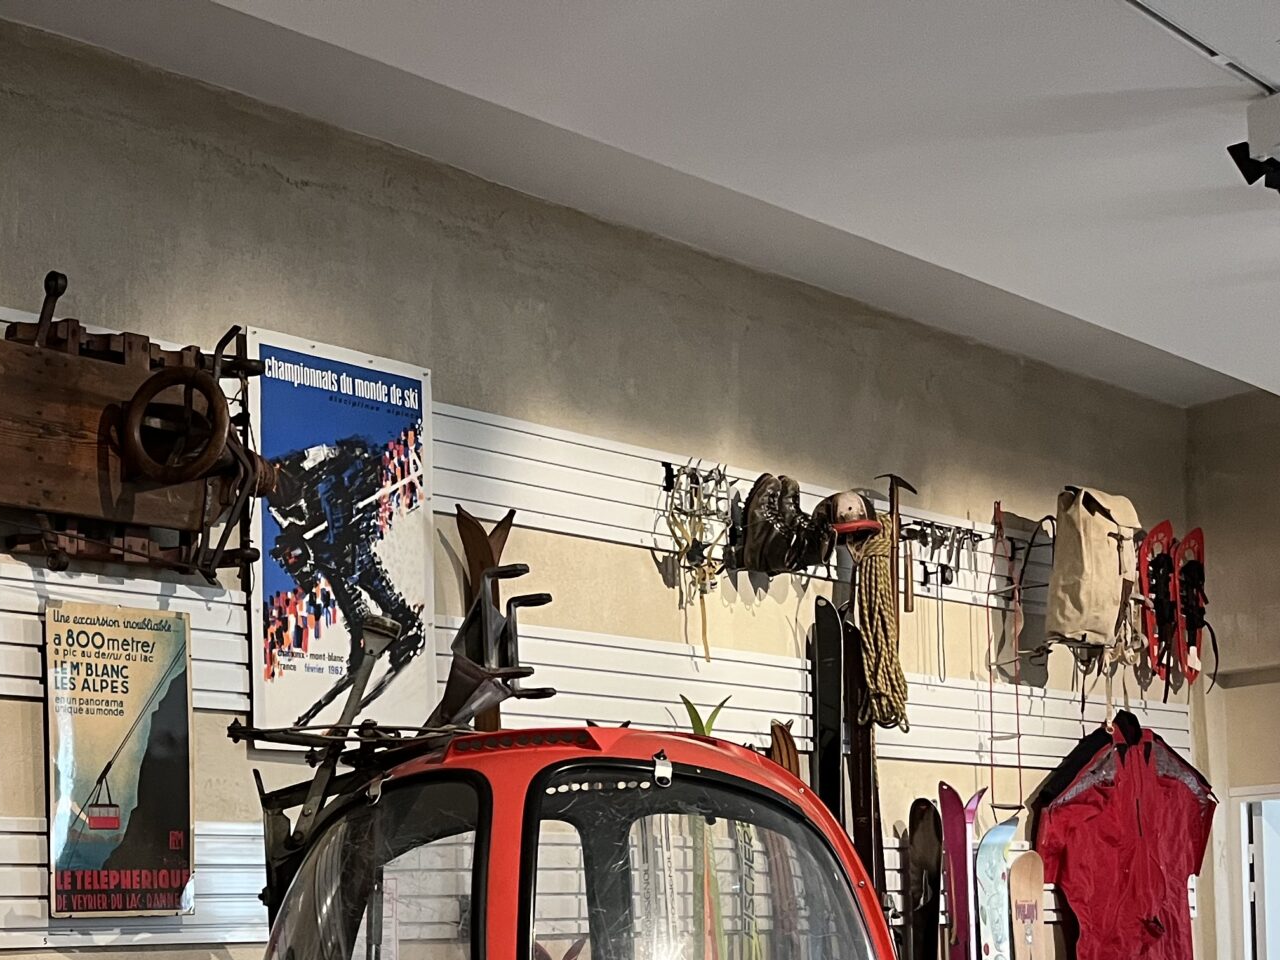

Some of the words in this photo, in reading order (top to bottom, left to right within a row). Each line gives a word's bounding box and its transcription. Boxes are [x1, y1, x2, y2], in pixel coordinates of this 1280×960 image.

[264, 356, 338, 392] championnats
[340, 373, 353, 395] du
[355, 378, 388, 403] monde
[390, 384, 402, 406] de
[404, 388, 418, 410] ski
[53, 610, 70, 623] Une
[73, 616, 119, 628] excursion
[66, 629, 105, 649] 800
[63, 649, 77, 659] pic
[81, 650, 92, 658] au
[125, 651, 137, 661] du
[140, 653, 154, 663] lac
[54, 660, 67, 674] LE
[86, 663, 129, 679] BLANC
[328, 666, 343, 675] 1962
[55, 676, 76, 691] LES
[81, 678, 129, 694] ALPES
[79, 698, 124, 710] panorama
[85, 707, 94, 715] au
[96, 707, 124, 716] monde
[57, 870, 71, 890] LE
[75, 869, 189, 890] TELEPHERIQUE
[742, 830, 756, 940] FISCHER
[57, 894, 67, 910] DE
[72, 894, 108, 910] VEYRIER
[642, 867, 651, 937] ROSSIGNOL
